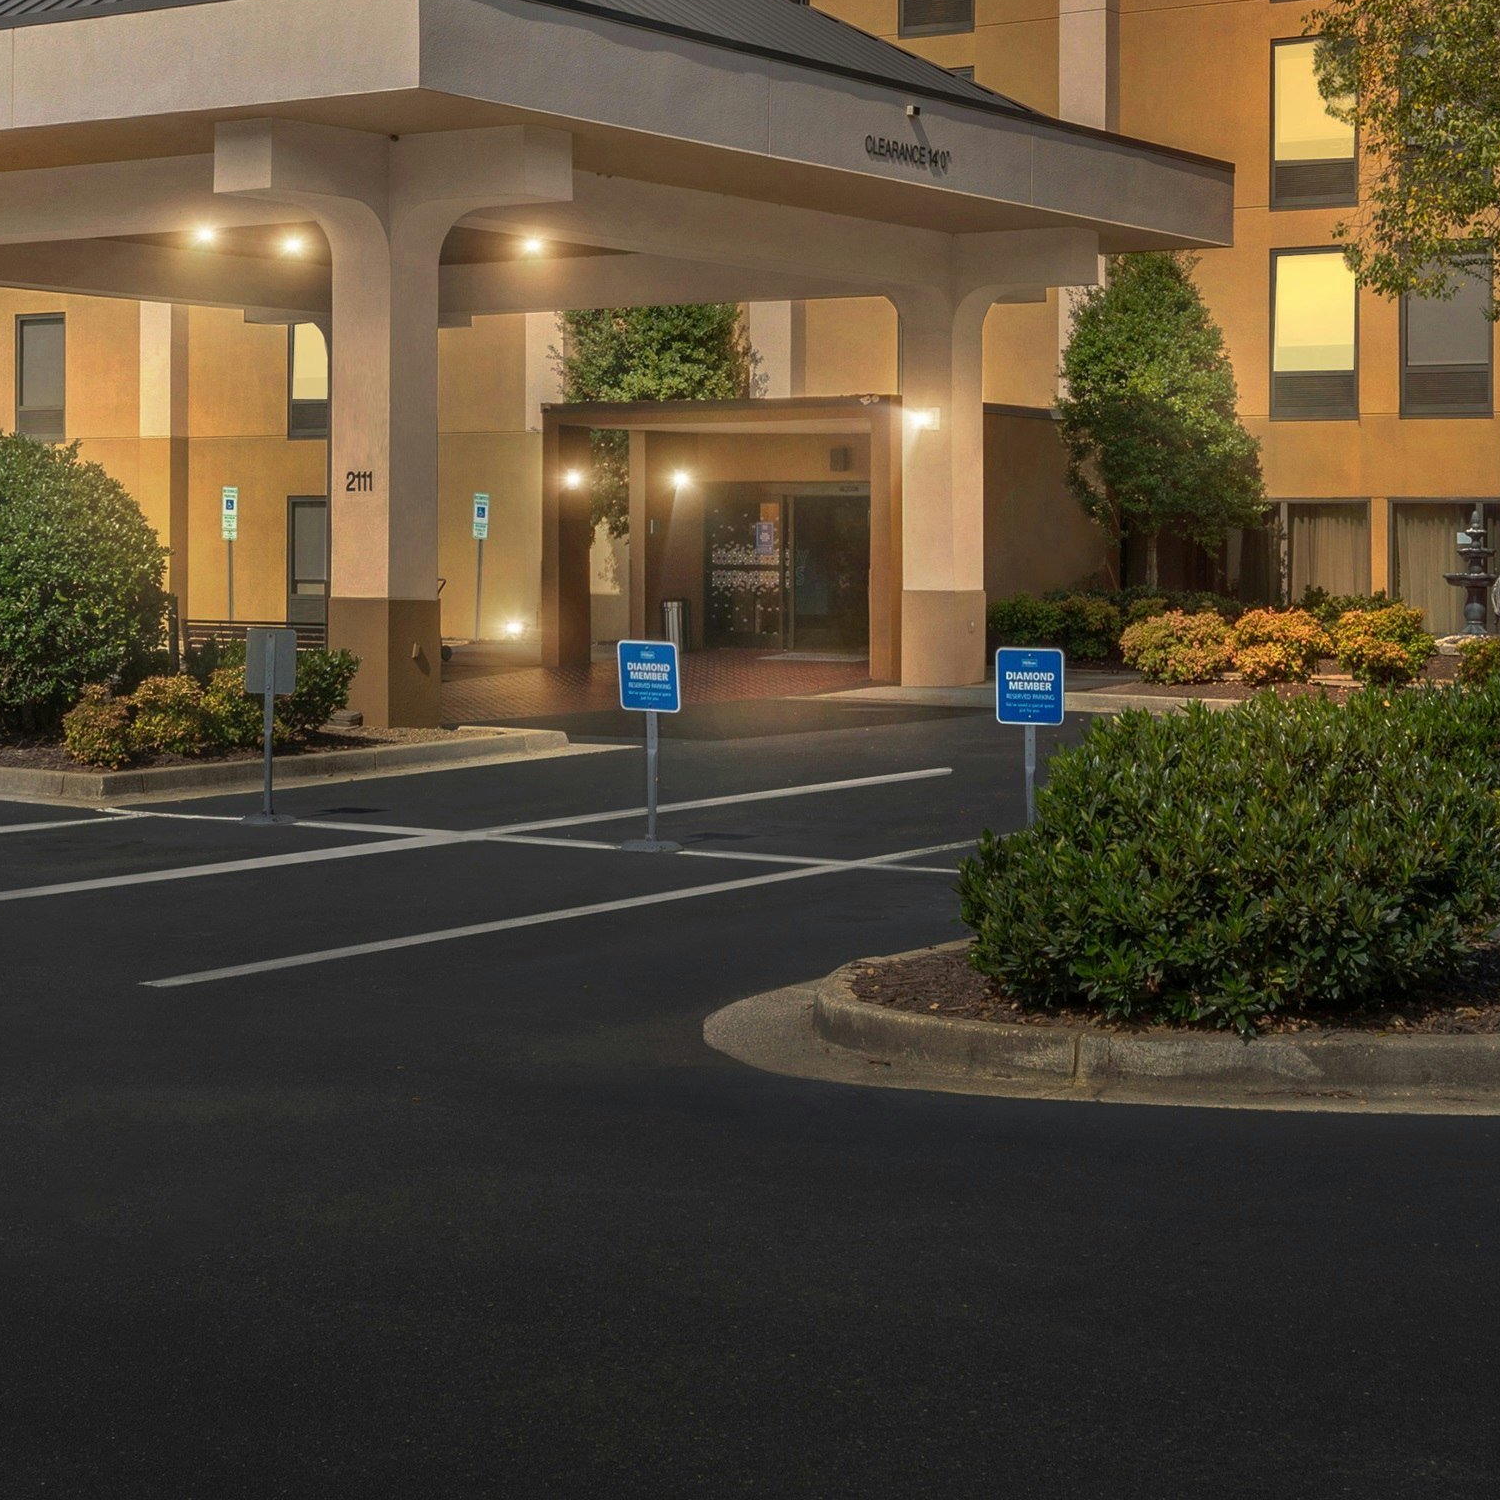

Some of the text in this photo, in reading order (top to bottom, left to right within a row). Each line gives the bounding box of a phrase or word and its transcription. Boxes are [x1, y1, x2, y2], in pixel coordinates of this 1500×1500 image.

[865, 134, 925, 165] CLEARANCE
[346, 471, 372, 491] 2111
[627, 662, 671, 672] DIAMOND
[630, 671, 669, 681] MEMBER
[1005, 672, 1055, 681] DIAMOND
[1008, 681, 1052, 691] MEMBER
